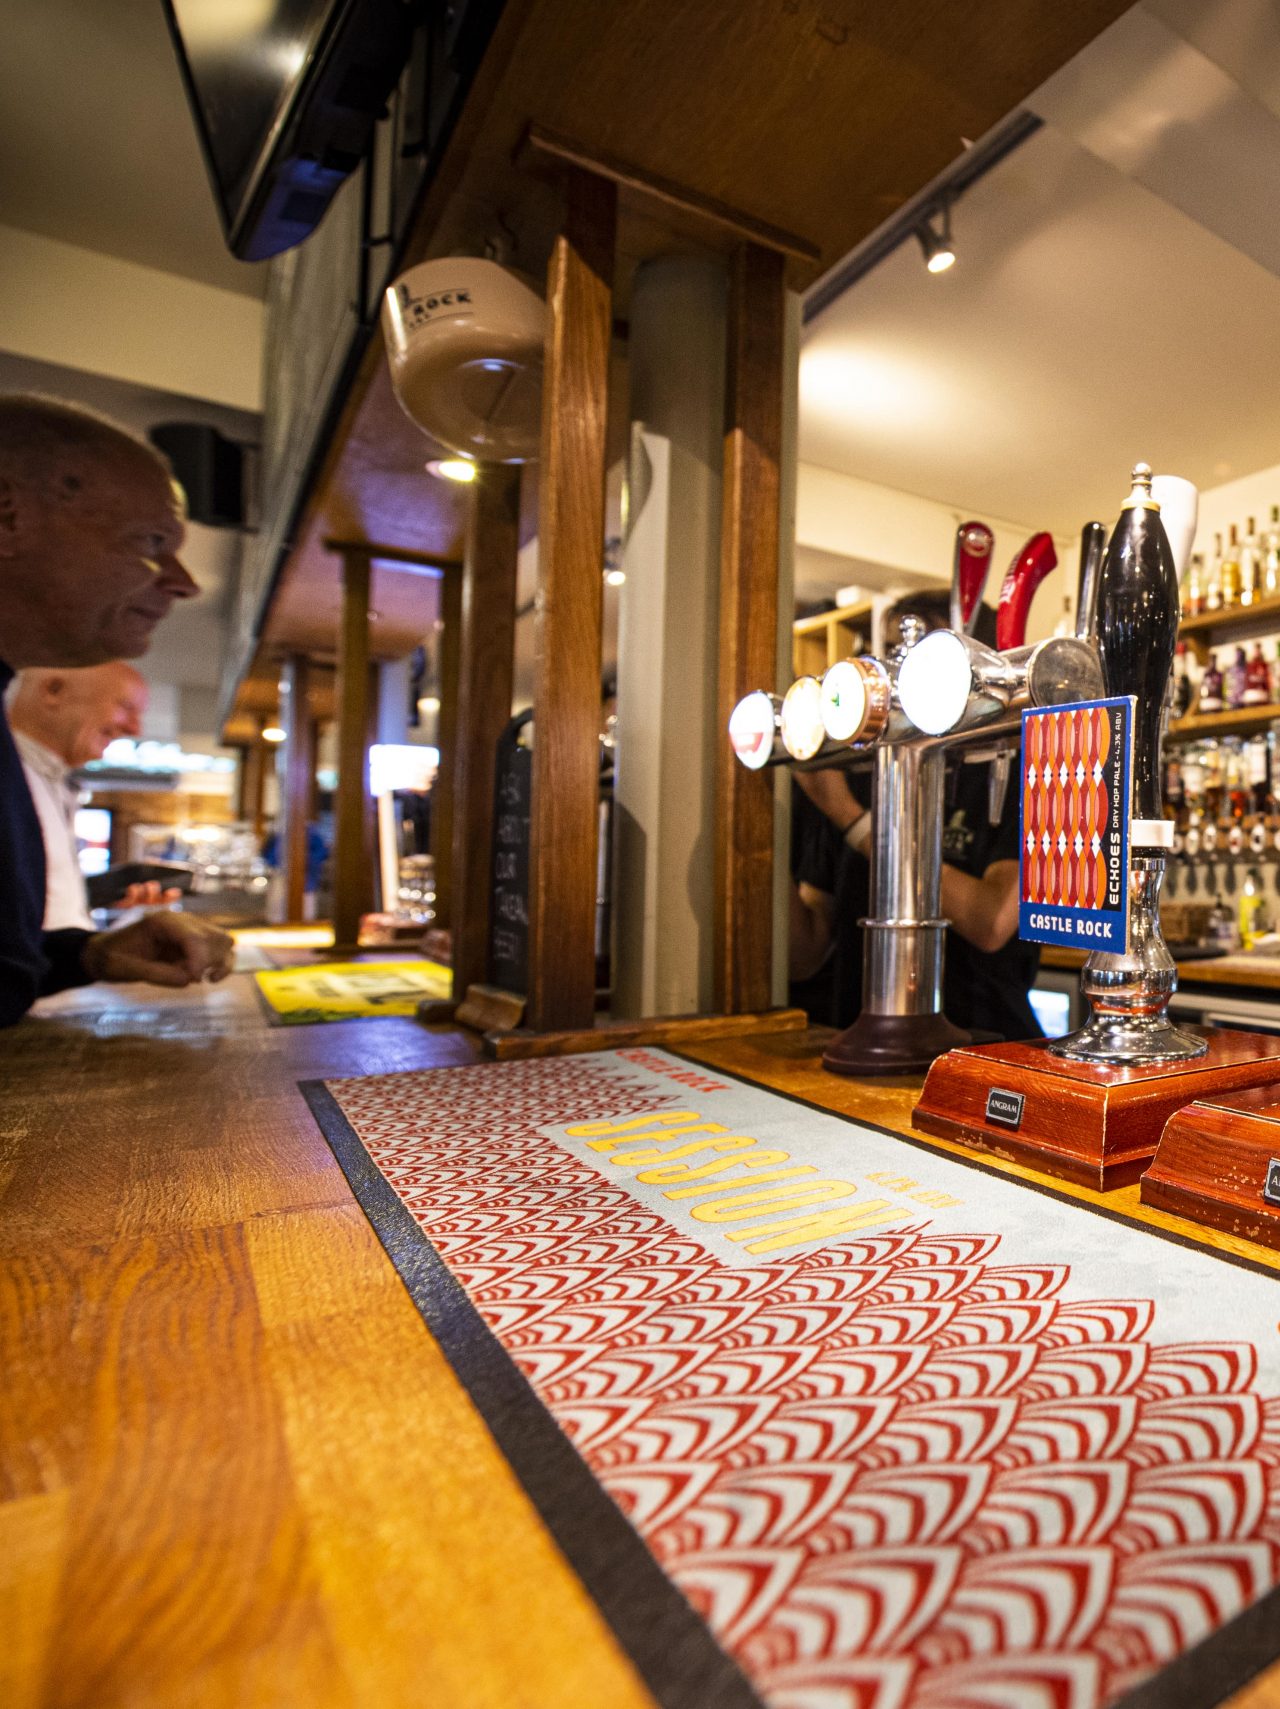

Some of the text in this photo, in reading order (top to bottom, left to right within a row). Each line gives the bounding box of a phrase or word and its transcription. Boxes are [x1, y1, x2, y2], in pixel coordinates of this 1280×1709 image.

[1113, 761, 1121, 786] PALE
[1112, 809, 1120, 828] DRY
[1109, 832, 1121, 905] ECHOES
[1029, 913, 1113, 939] CASTLE ROCK
[990, 1099, 1018, 1114] ANGRAM
[565, 1111, 915, 1256] SESSION
